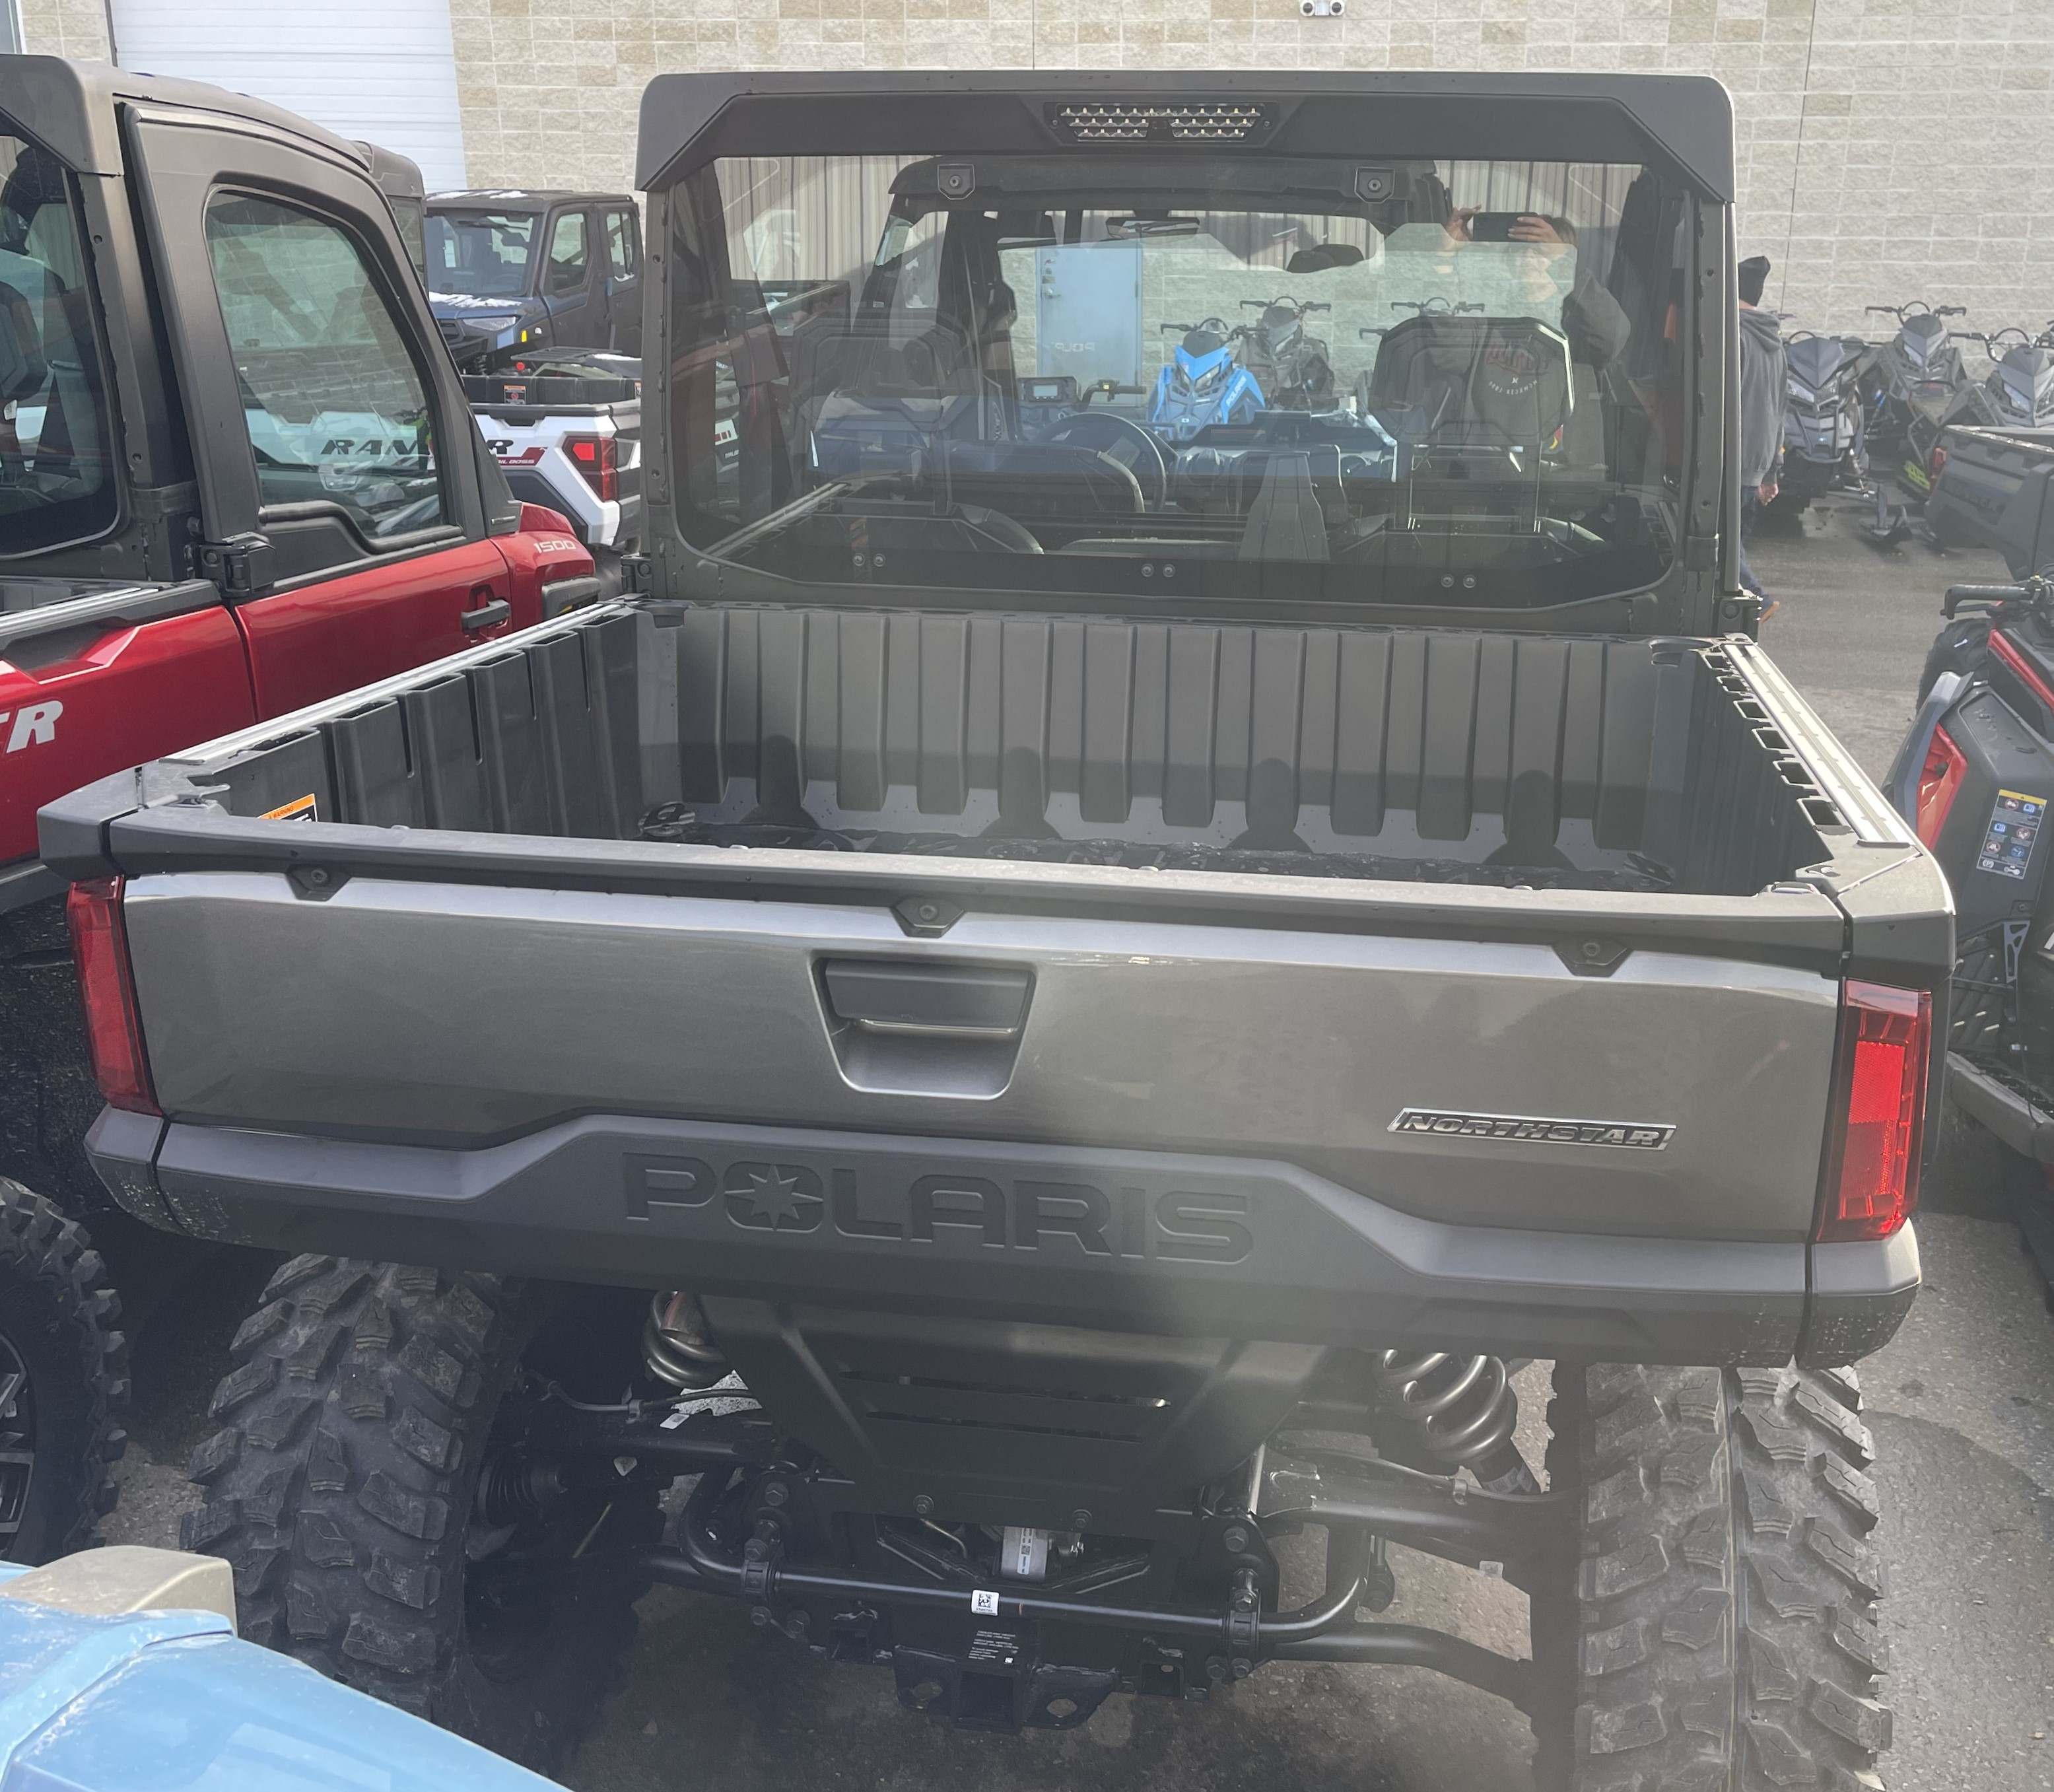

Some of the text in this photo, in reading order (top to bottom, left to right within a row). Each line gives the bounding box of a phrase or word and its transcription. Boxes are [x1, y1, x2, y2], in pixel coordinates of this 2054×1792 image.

[1226, 375, 1247, 407] POLARIS
[533, 541, 576, 553] 1500
[0, 700, 63, 753] R
[1402, 1116, 1660, 1145] NORTHSTAR
[623, 1152, 1253, 1265] POLARIS
